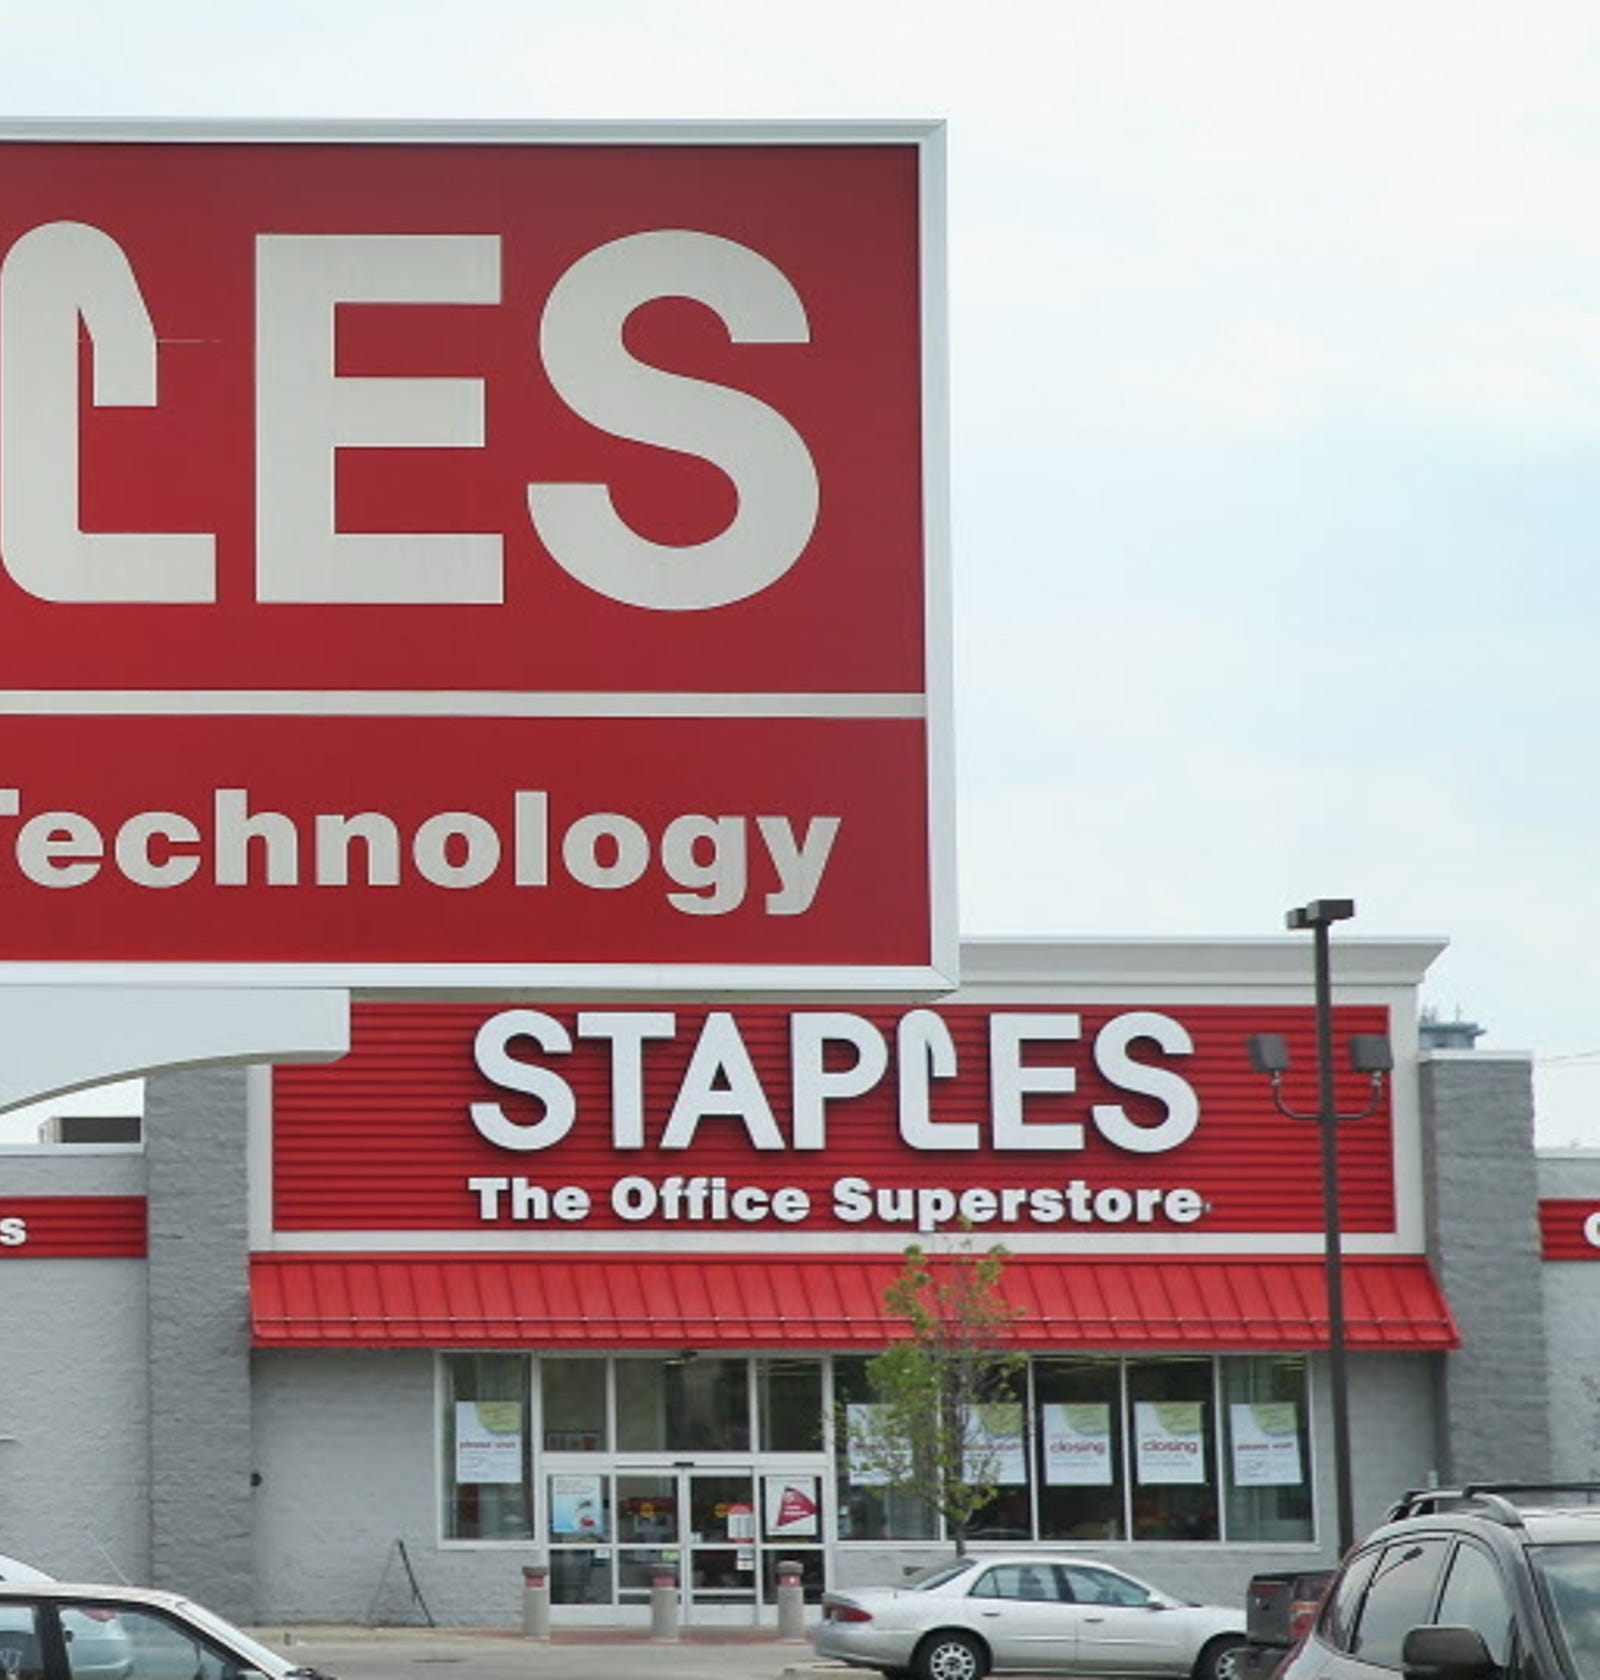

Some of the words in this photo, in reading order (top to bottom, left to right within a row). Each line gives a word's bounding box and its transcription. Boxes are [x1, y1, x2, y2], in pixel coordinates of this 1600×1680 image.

[470, 1009, 1199, 1152] STAPLES
[469, 1177, 590, 1220] The
[612, 1176, 810, 1221] Office
[834, 1177, 1201, 1231] Superstore
[1051, 1442, 1105, 1455] closing
[1143, 1442, 1198, 1454] closing
